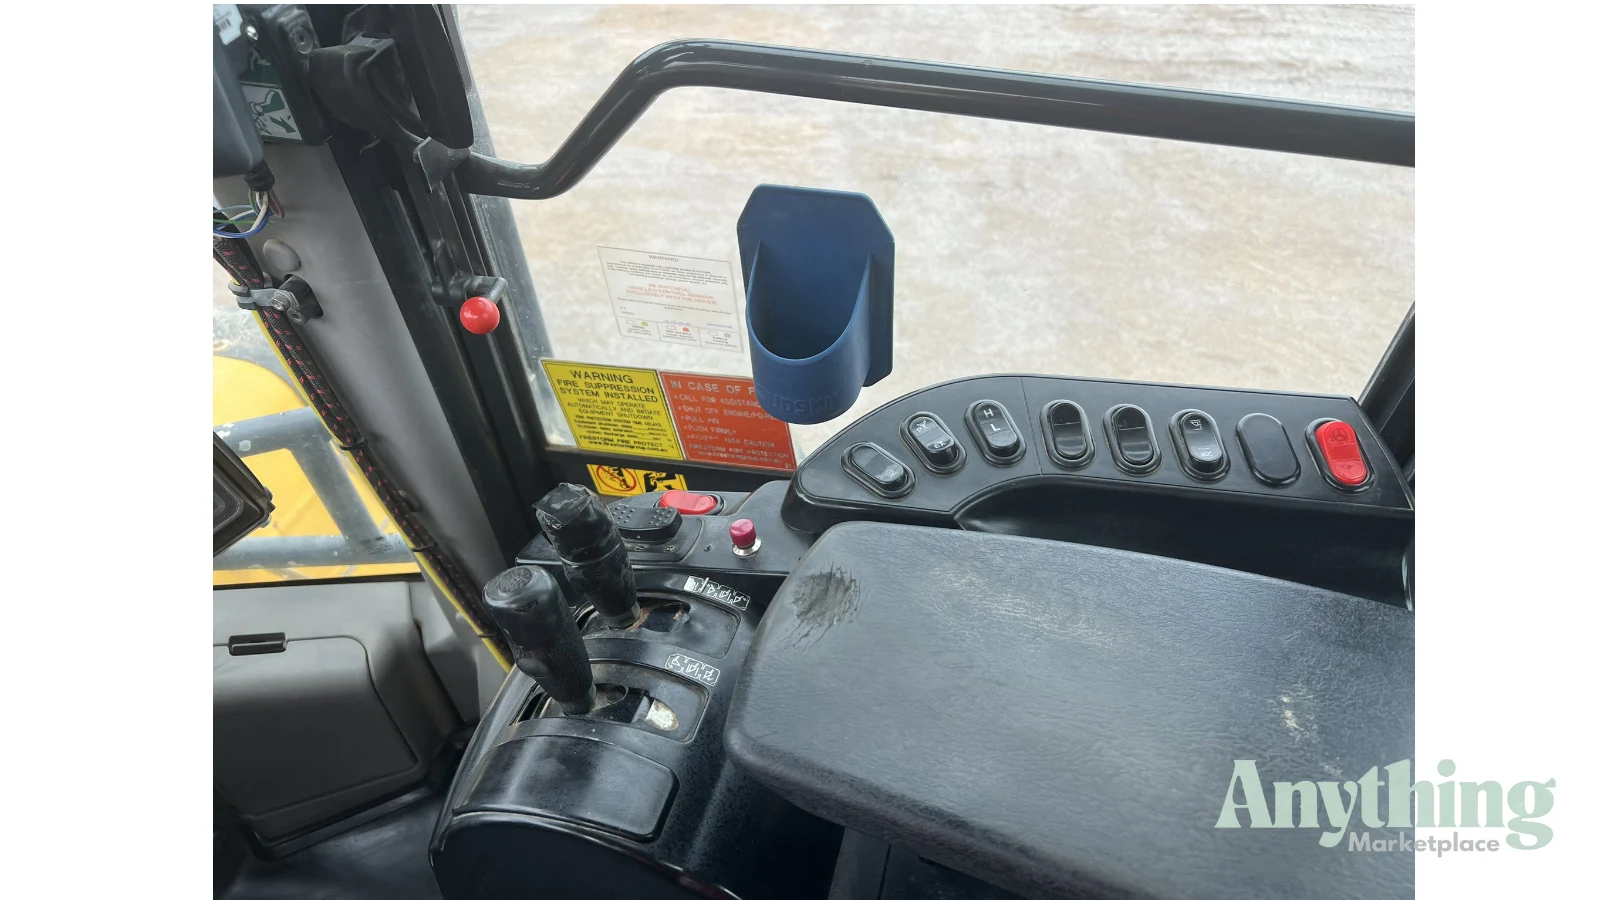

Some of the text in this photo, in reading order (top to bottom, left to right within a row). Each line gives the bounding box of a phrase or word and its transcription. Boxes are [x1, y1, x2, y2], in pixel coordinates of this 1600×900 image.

[570, 370, 634, 383] WARNING
[557, 378, 655, 395] FIRE SUPPRESSION
[670, 380, 682, 388] IN
[687, 382, 720, 392] CASE
[726, 385, 741, 394] OF
[559, 387, 658, 403] SYSTEM INSTALLED
[617, 401, 646, 409] OPERATE
[679, 394, 761, 408] CALL FOR ASSISTANC
[567, 402, 617, 412] AUTOMATICALLY
[682, 405, 701, 413] SHUT
[578, 408, 614, 417] EQUIPMENT
[983, 408, 994, 418] H
[990, 423, 1001, 432] L
